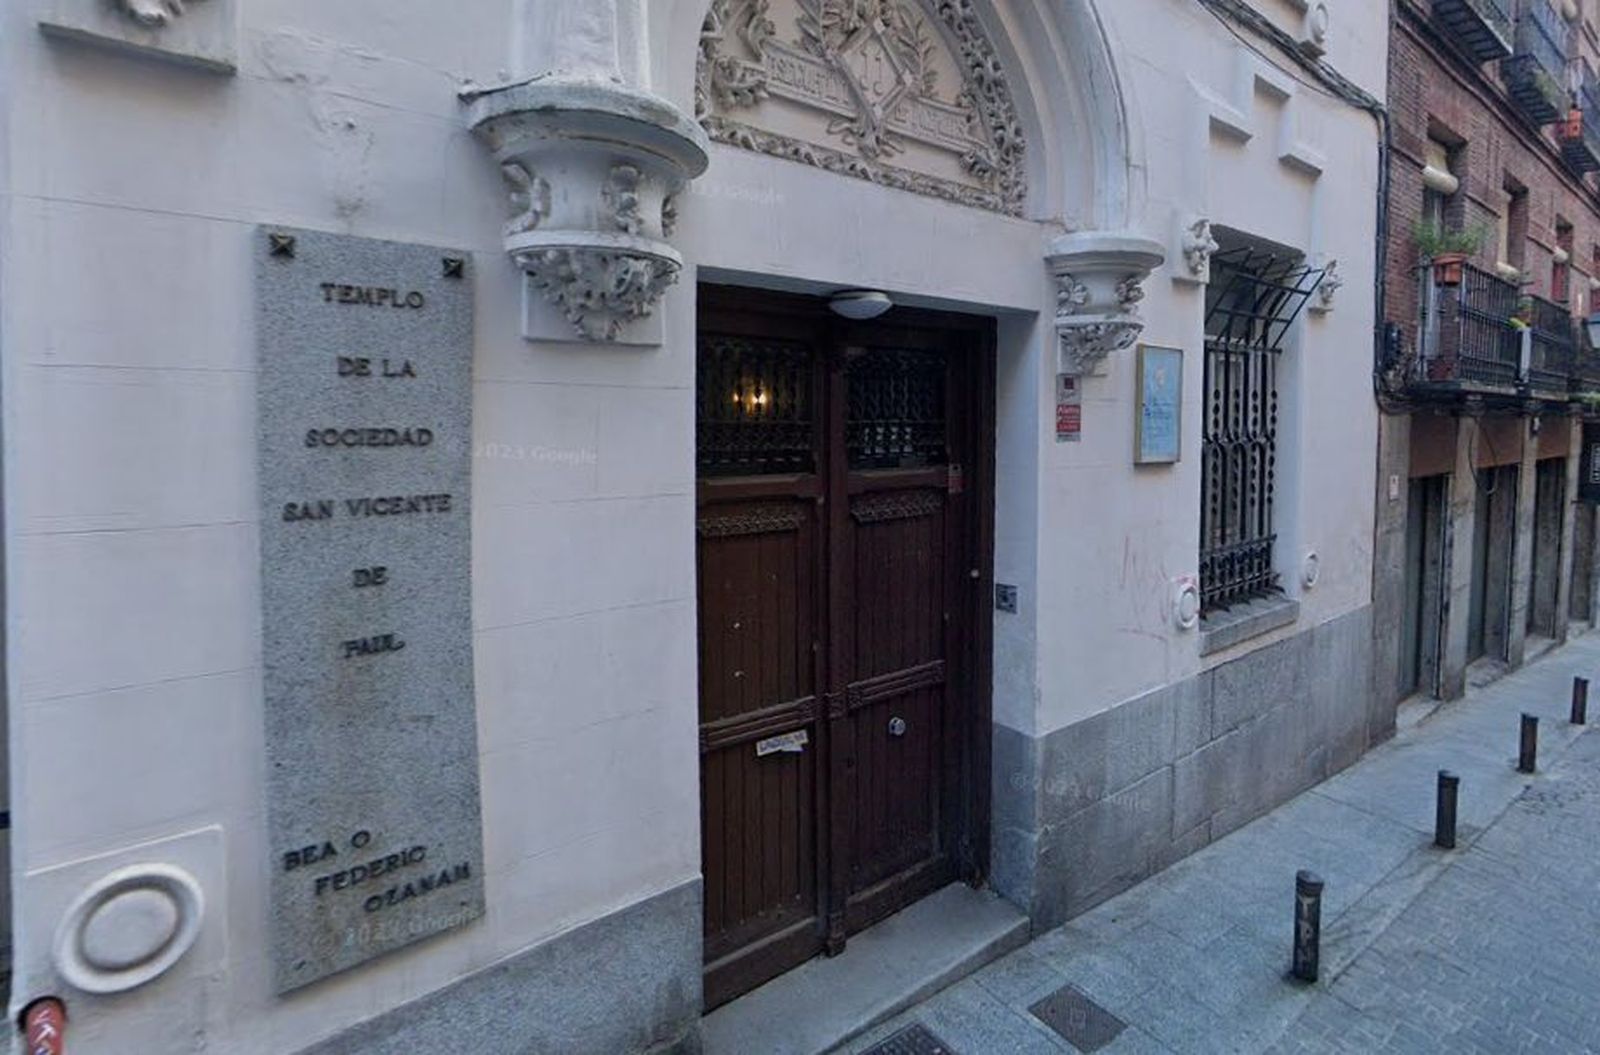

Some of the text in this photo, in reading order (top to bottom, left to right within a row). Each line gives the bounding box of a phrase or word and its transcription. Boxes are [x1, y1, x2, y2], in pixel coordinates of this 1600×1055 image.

[319, 282, 425, 309] TEMPLO
[336, 355, 417, 380] DE LA
[305, 427, 434, 449] SOCIEDAD
[282, 493, 453, 522] SAN VICENTE
[351, 566, 389, 588] DE
[339, 633, 406, 659] PAUL
[362, 861, 471, 913] OZANAM
